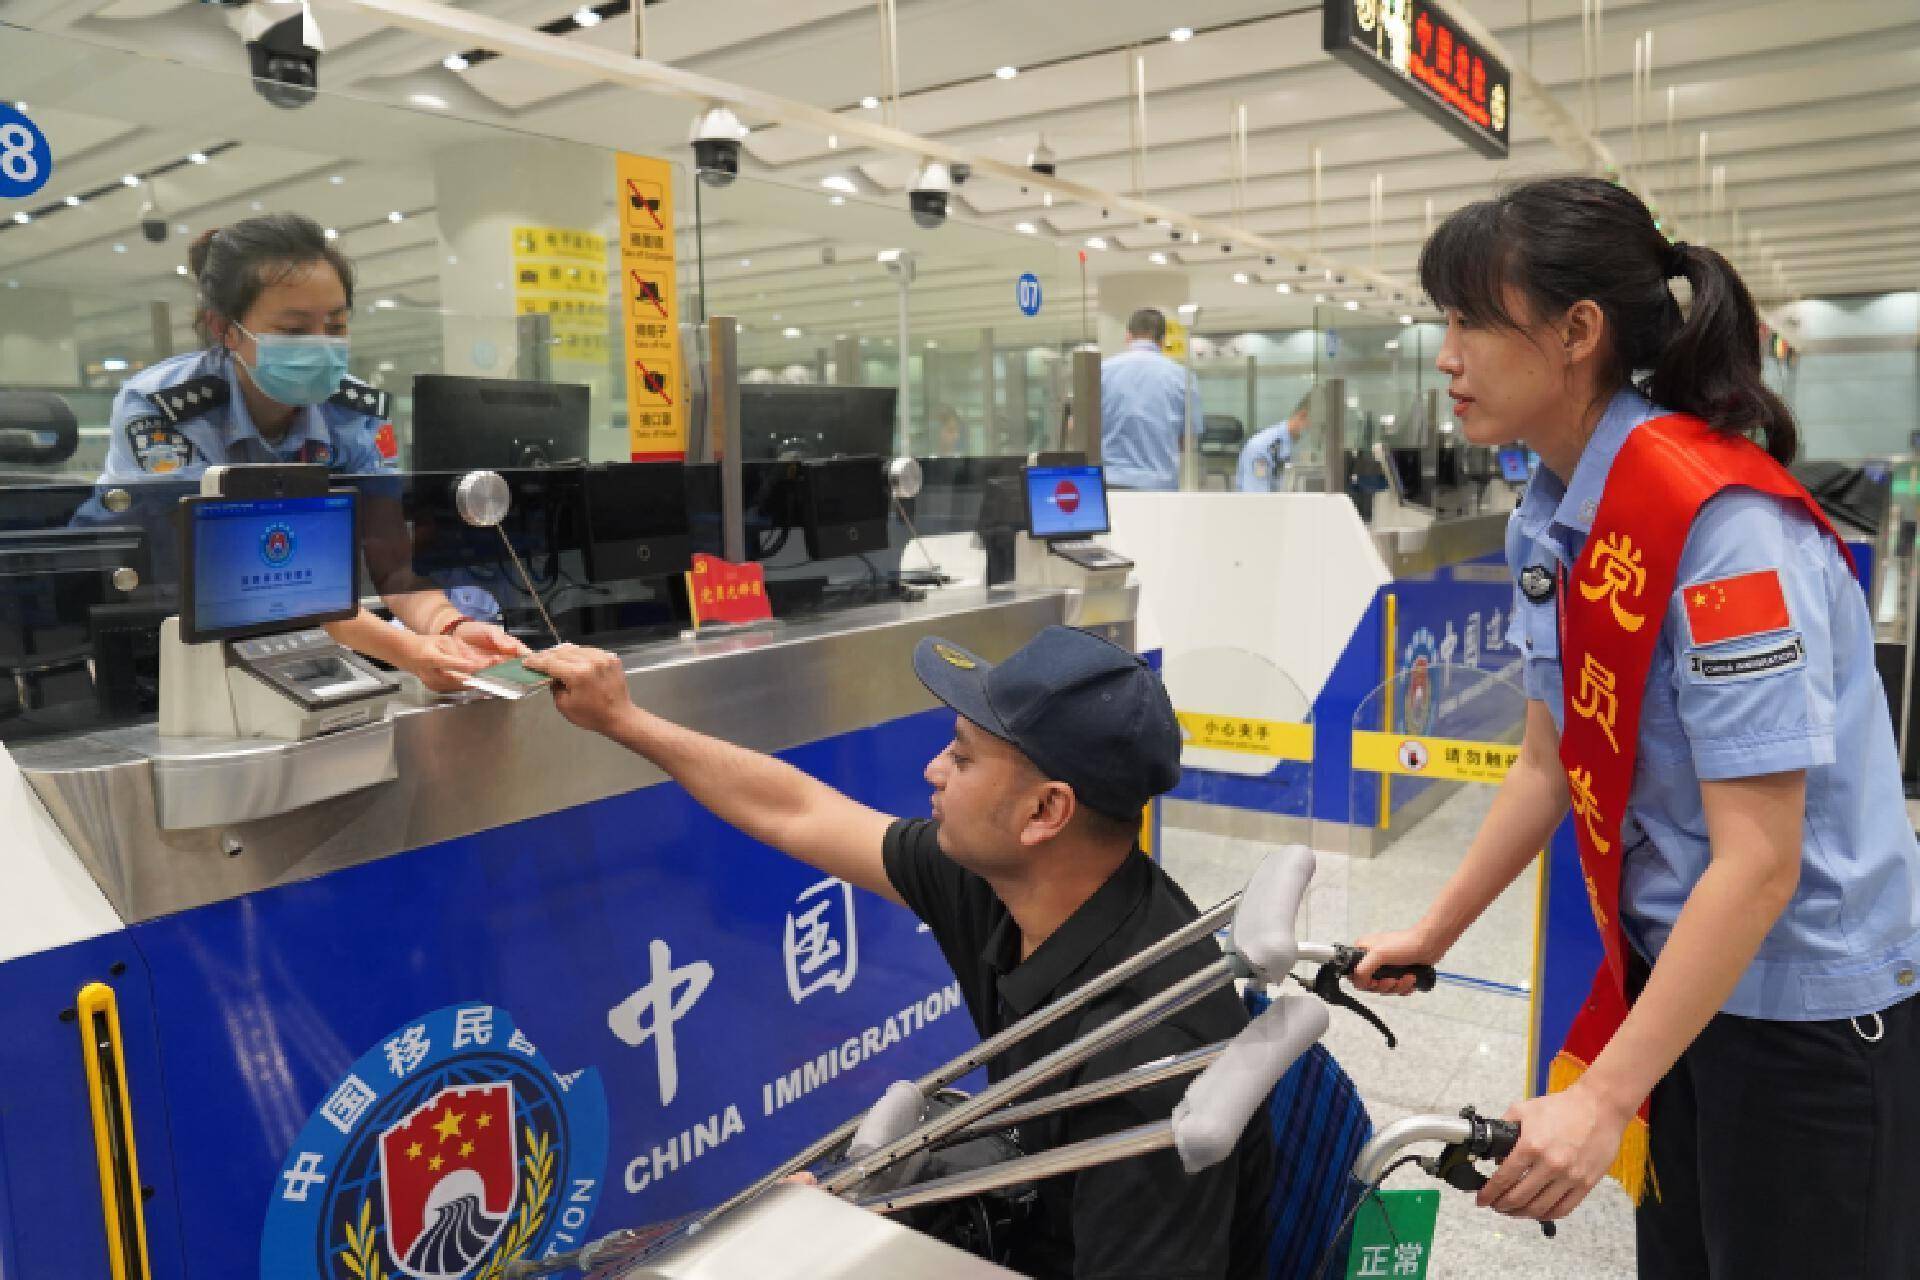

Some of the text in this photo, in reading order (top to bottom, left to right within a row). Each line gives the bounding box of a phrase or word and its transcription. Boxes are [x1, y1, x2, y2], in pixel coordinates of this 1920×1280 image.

[0, 124, 37, 182] 8
[1020, 279, 1037, 308] 07
[608, 876, 932, 1107] 中国
[625, 980, 962, 1193] CHINA IMMIGRATION
[1356, 1242, 1424, 1277] 正常
